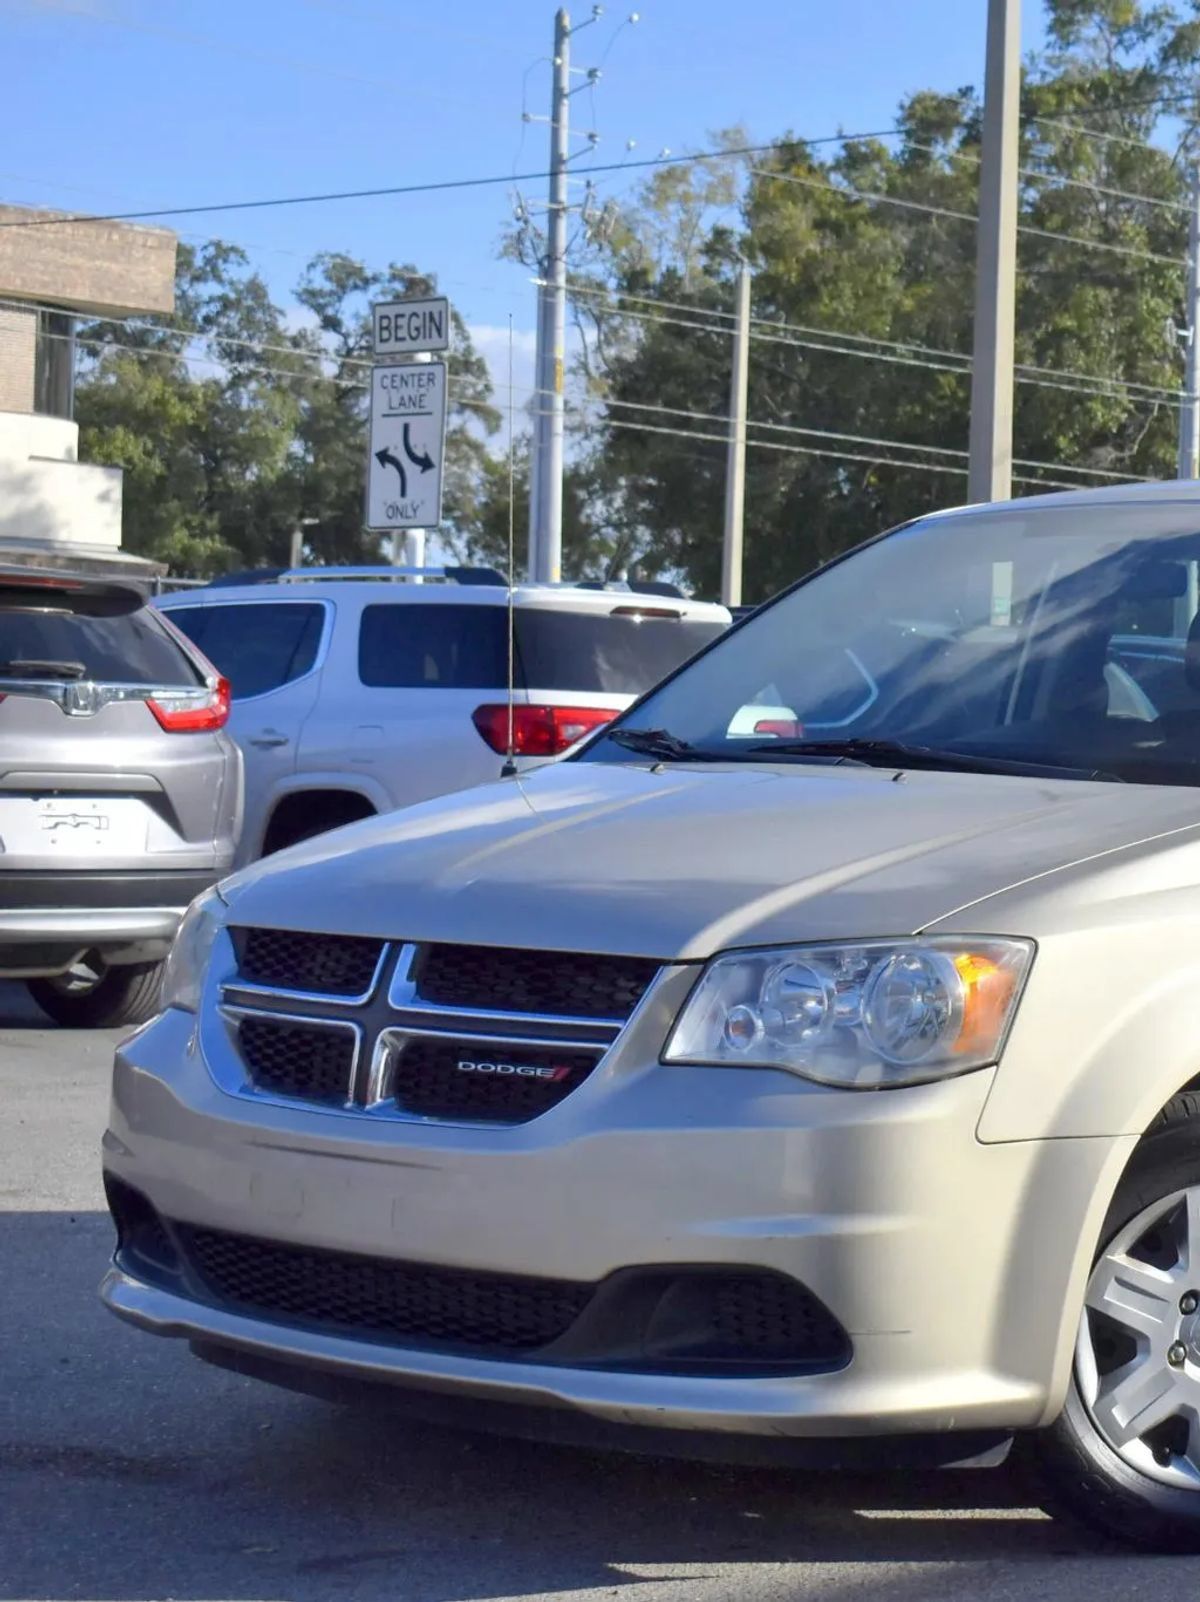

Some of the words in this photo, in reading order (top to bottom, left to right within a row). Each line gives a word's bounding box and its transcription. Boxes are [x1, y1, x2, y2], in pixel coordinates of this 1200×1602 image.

[378, 309, 444, 344] BEGIN
[380, 371, 436, 390] CENTER
[388, 392, 428, 411] LANE
[385, 502, 421, 521] ONLY
[458, 1061, 556, 1079] DODGE
